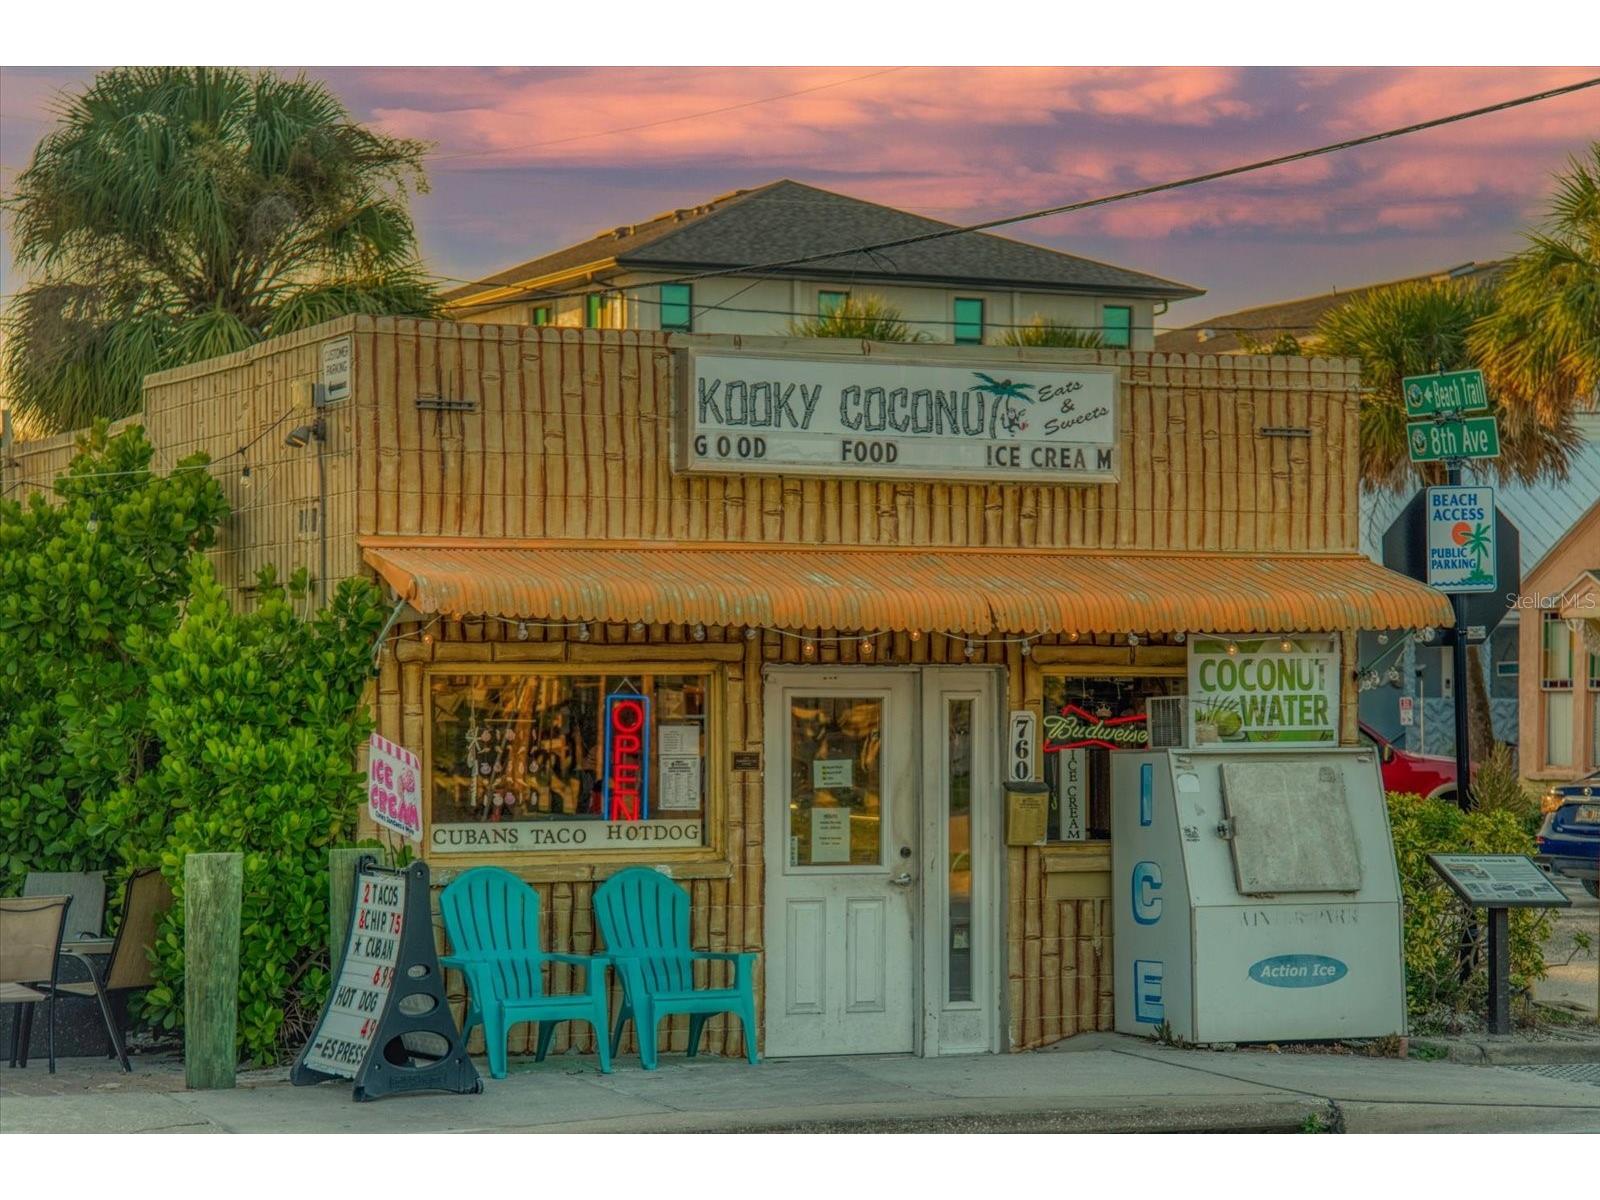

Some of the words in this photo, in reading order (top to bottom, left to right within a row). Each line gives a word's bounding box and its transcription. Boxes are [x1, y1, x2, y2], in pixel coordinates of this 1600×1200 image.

[698, 377, 822, 430] KOOKY
[1037, 380, 1084, 403] Eats
[1432, 380, 1461, 409] Beach
[1461, 374, 1485, 406] Trail
[1044, 406, 1110, 436] Sweets
[1060, 401, 1076, 414] &
[693, 434, 767, 459] GOOD
[841, 440, 898, 464] FOOD
[987, 445, 1021, 467] ICE
[1030, 446, 1112, 470] CREAM
[1430, 425, 1457, 455] 8th
[1462, 424, 1489, 453] Ave
[1432, 493, 1478, 507] BEACH
[1432, 507, 1485, 521] ACCESS
[1431, 547, 1468, 559] PUBLIC
[1431, 558, 1477, 570] PARKING
[1199, 657, 1327, 693] COCONUT
[1239, 694, 1329, 727] WATER
[1043, 715, 1149, 743] Budweise
[613, 701, 645, 822] OPEN
[1015, 719, 1029, 781] 760
[371, 758, 393, 790] ICE
[371, 783, 419, 832] CREAM
[1067, 786, 1081, 840] CREAM
[432, 827, 519, 846] CUBANS
[530, 828, 587, 845] TACO
[364, 883, 370, 904] 2
[372, 883, 398, 906] TACOS
[1131, 763, 1165, 1025] ICE
[366, 937, 394, 961] CUBAN
[1260, 962, 1308, 979] Action
[1311, 962, 1337, 978] Ice
[335, 985, 358, 1008] HOT
[358, 990, 379, 1013] DOG
